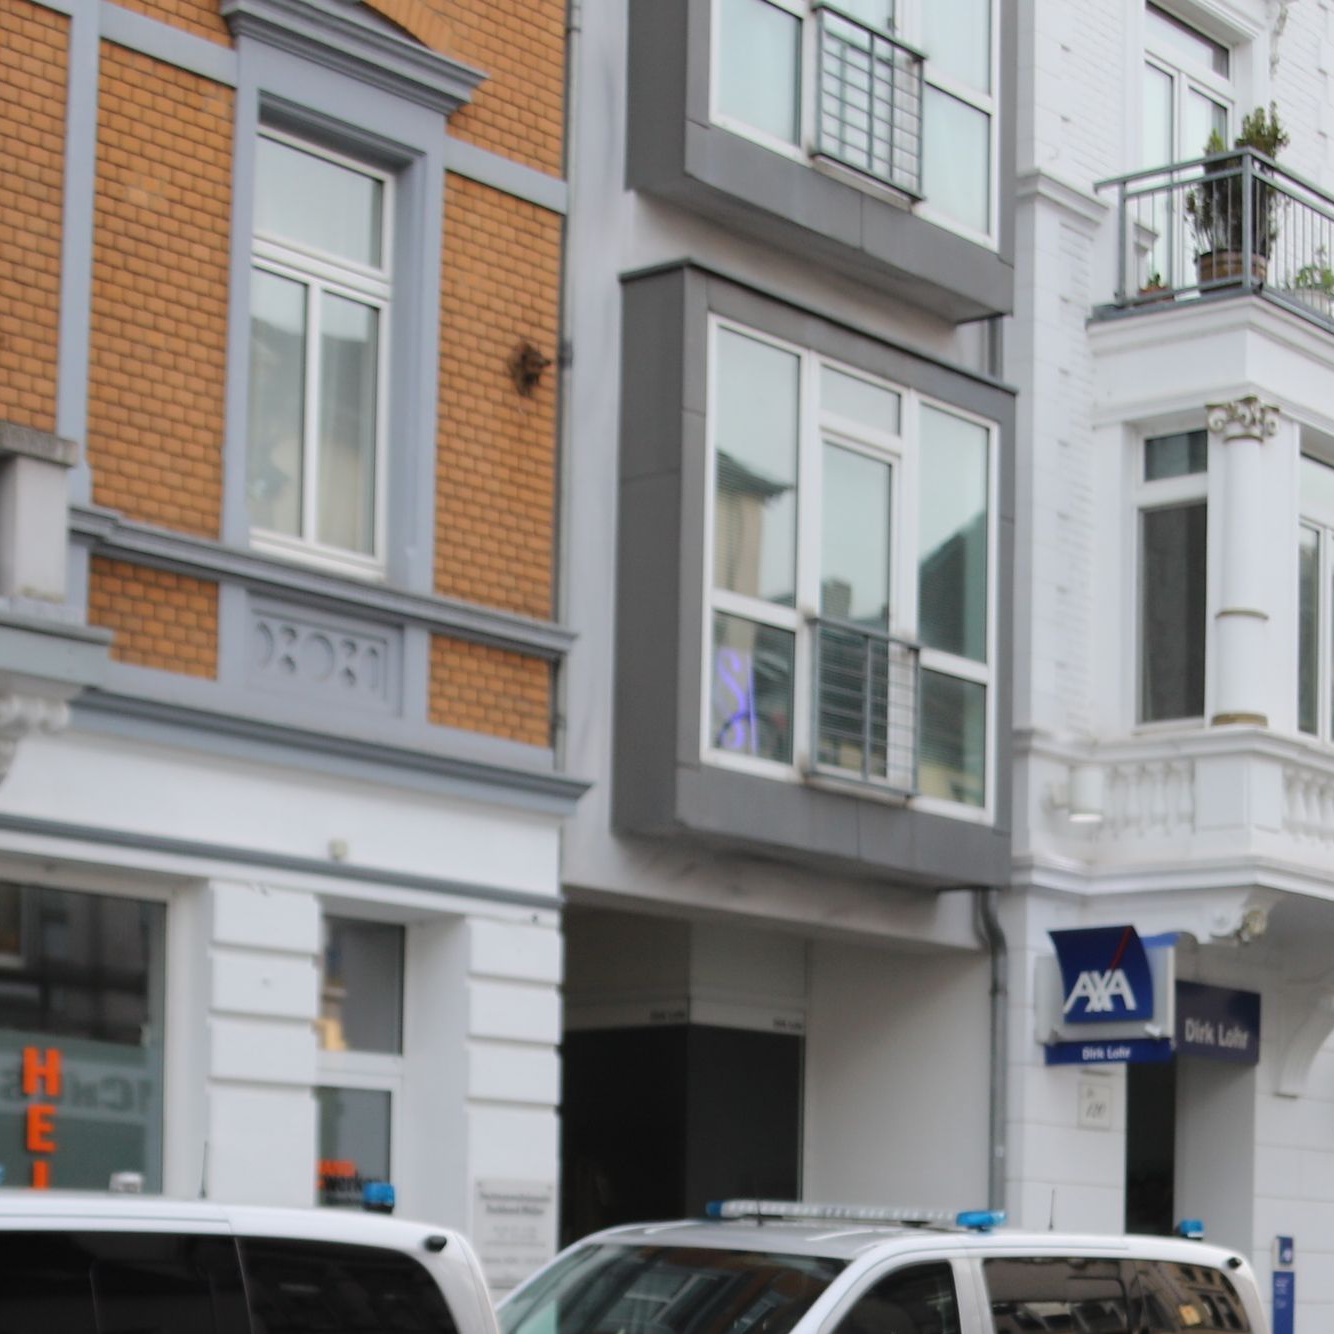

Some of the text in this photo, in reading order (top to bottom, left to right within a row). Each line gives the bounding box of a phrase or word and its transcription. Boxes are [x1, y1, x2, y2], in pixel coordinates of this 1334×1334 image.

[1063, 968, 1137, 1013] AXA
[1184, 1018, 1249, 1050] Dirk Lohr
[1082, 1045, 1131, 1060] Dirk Lohr
